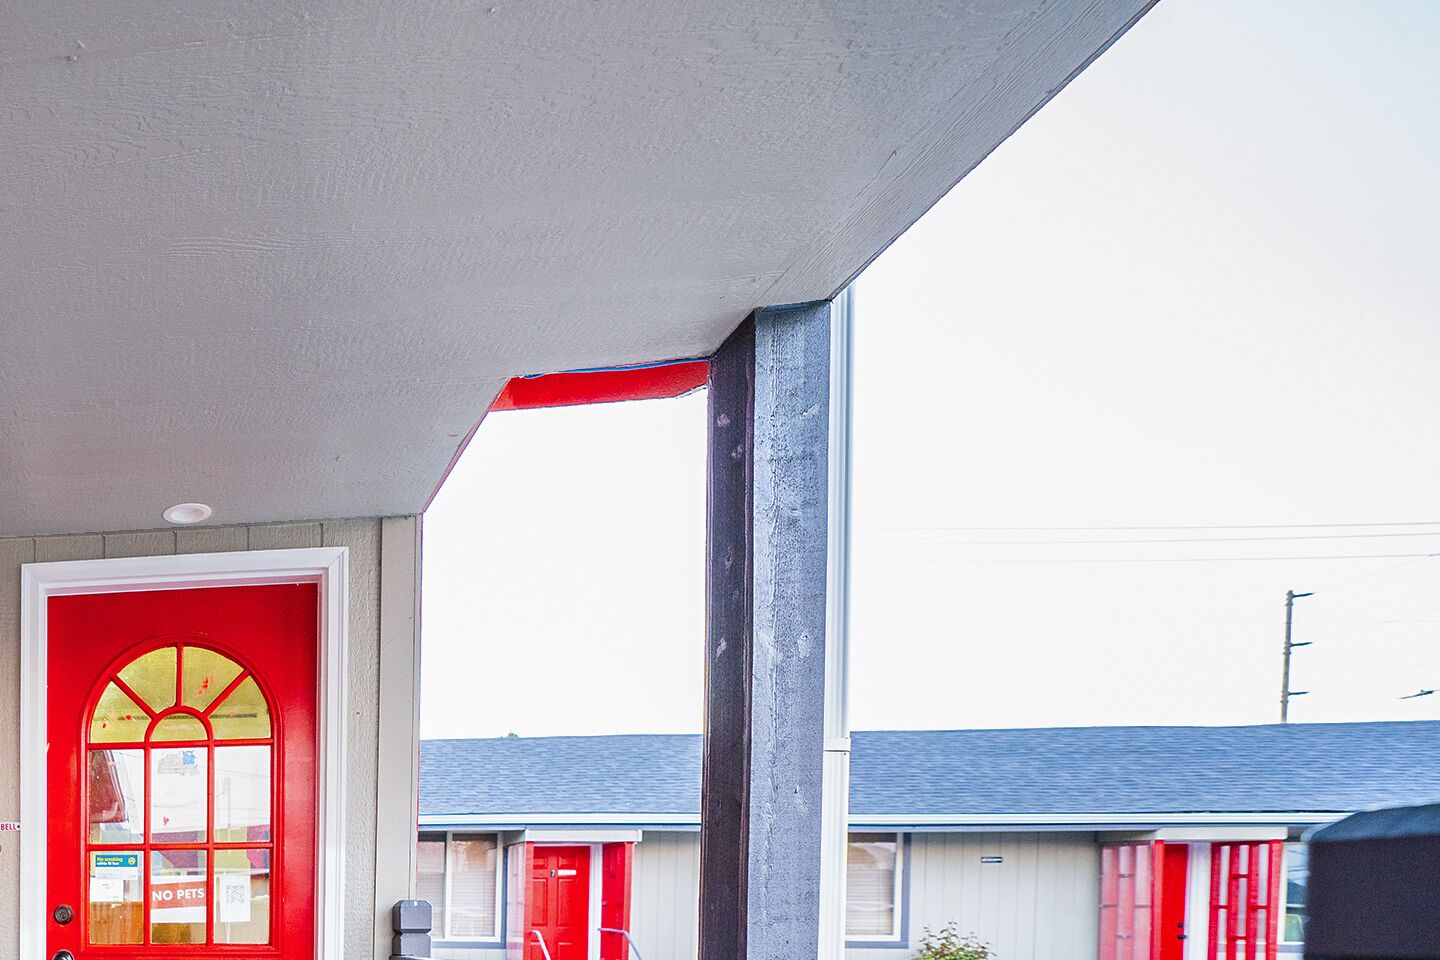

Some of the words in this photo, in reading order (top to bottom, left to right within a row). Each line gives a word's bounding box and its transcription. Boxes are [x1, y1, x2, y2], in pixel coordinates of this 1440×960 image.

[0, 823, 17, 831] BELL
[152, 889, 173, 901] NO
[177, 887, 205, 900] PETS
